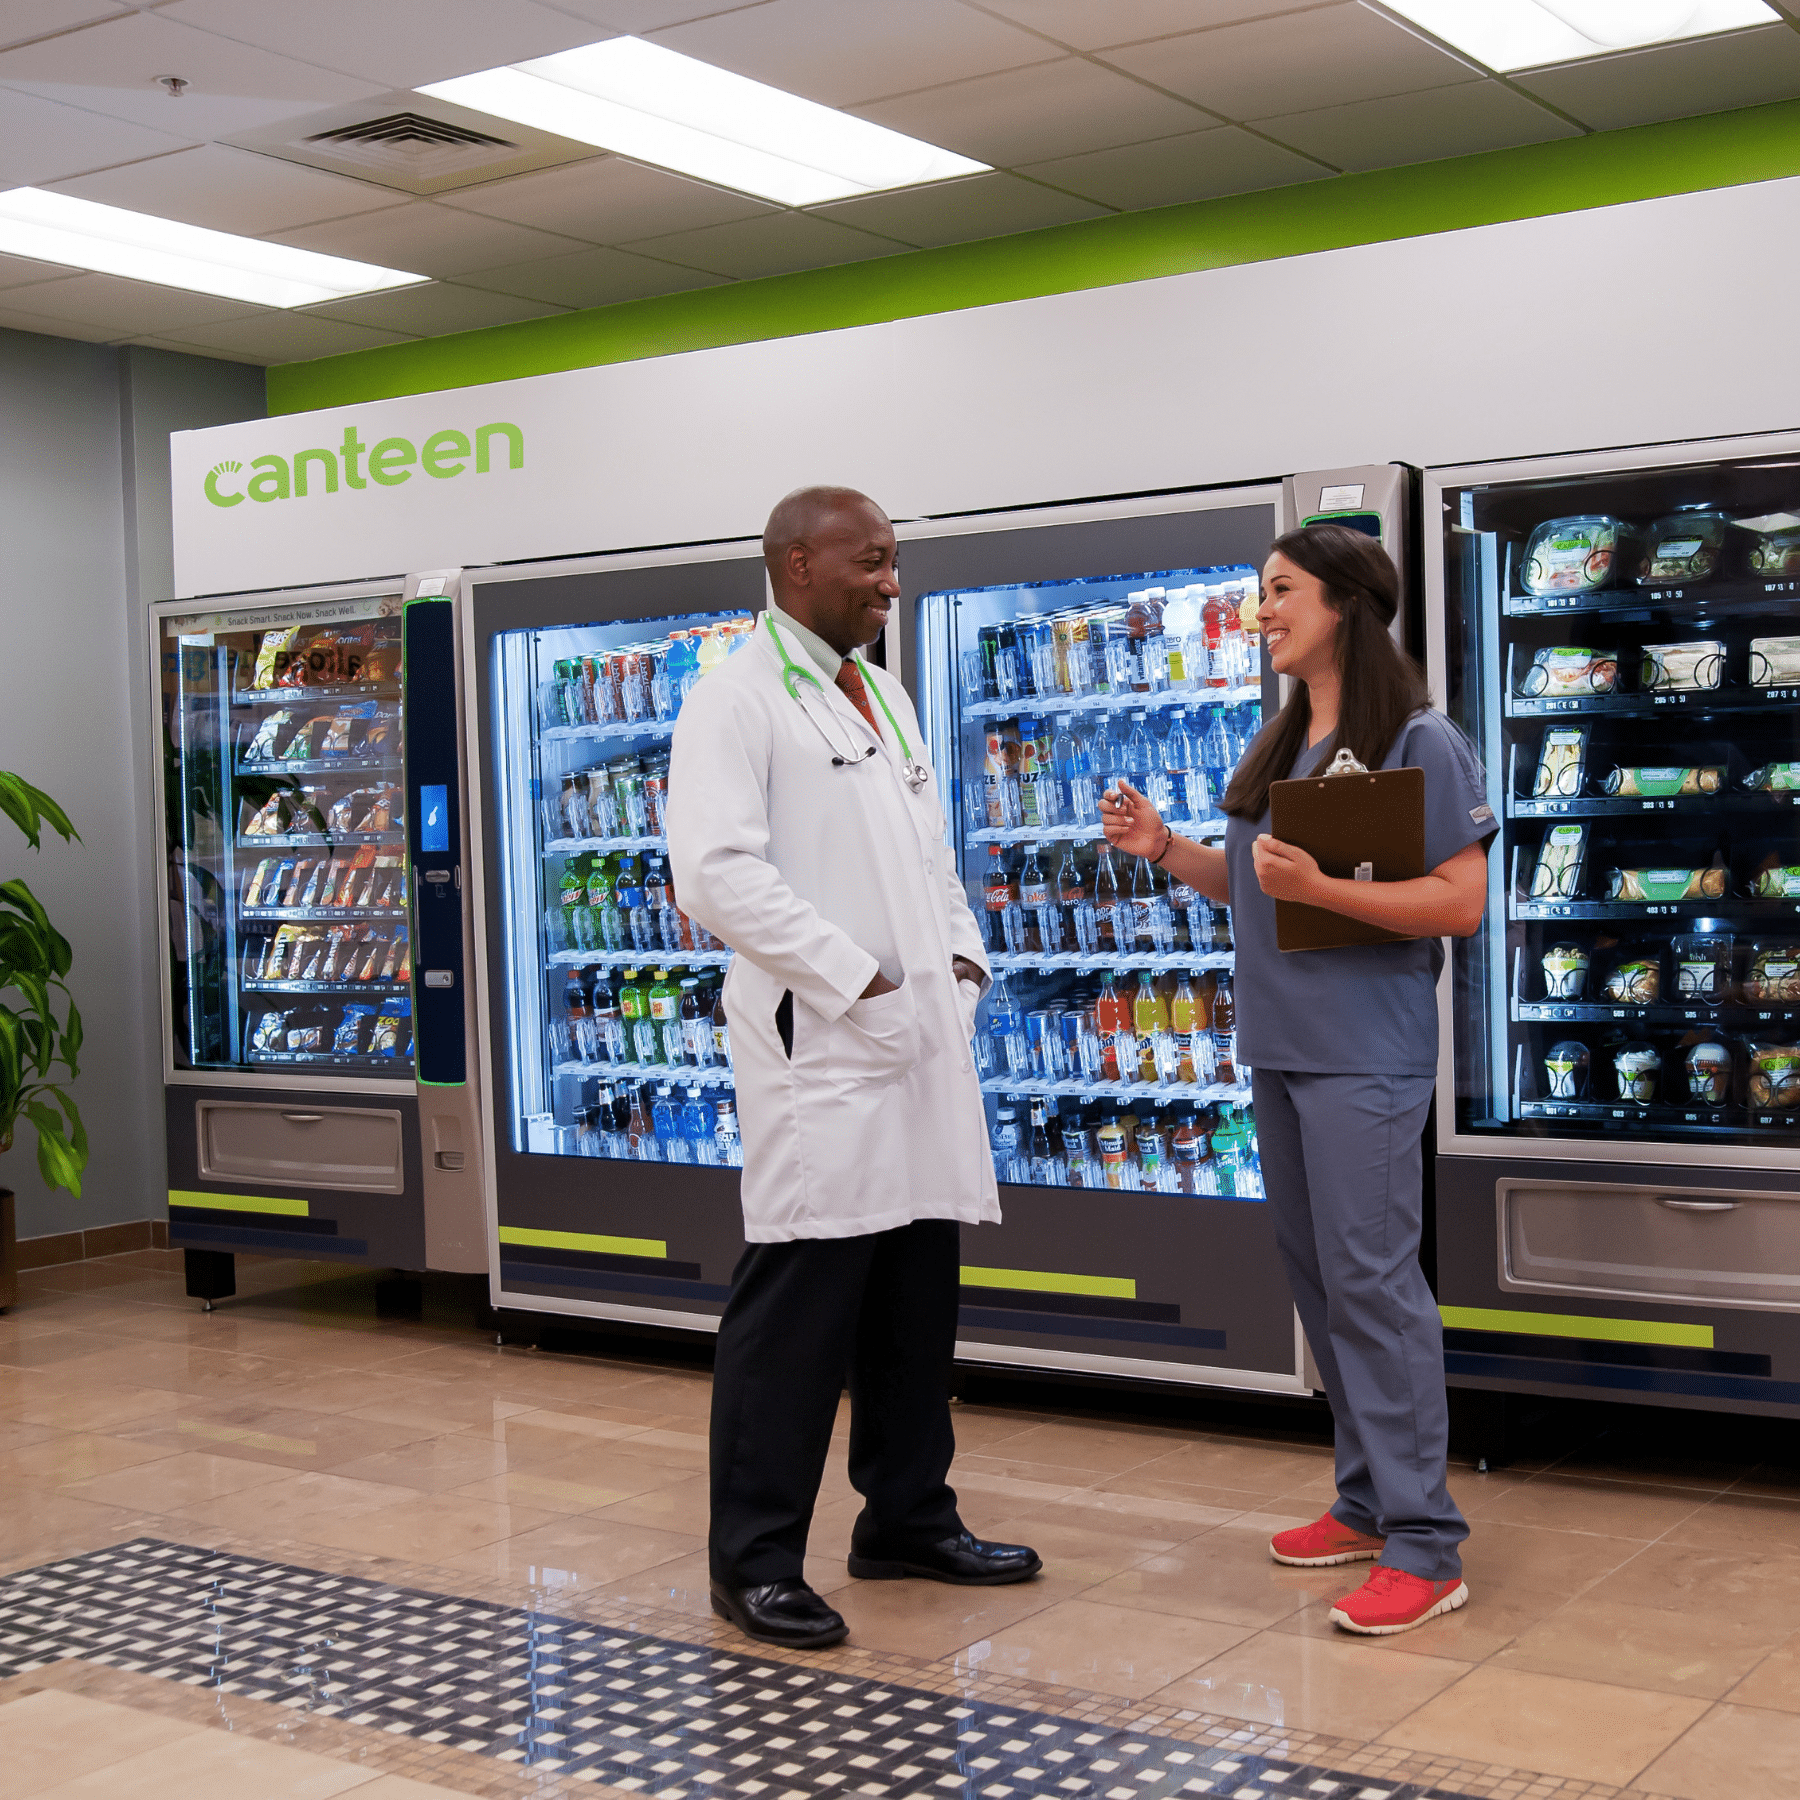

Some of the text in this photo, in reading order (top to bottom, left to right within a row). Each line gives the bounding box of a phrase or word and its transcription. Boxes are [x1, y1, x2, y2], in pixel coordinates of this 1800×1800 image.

[204, 422, 524, 508] canteen
[228, 606, 357, 627] Snack Smart. Snack Now. Snack Well.
